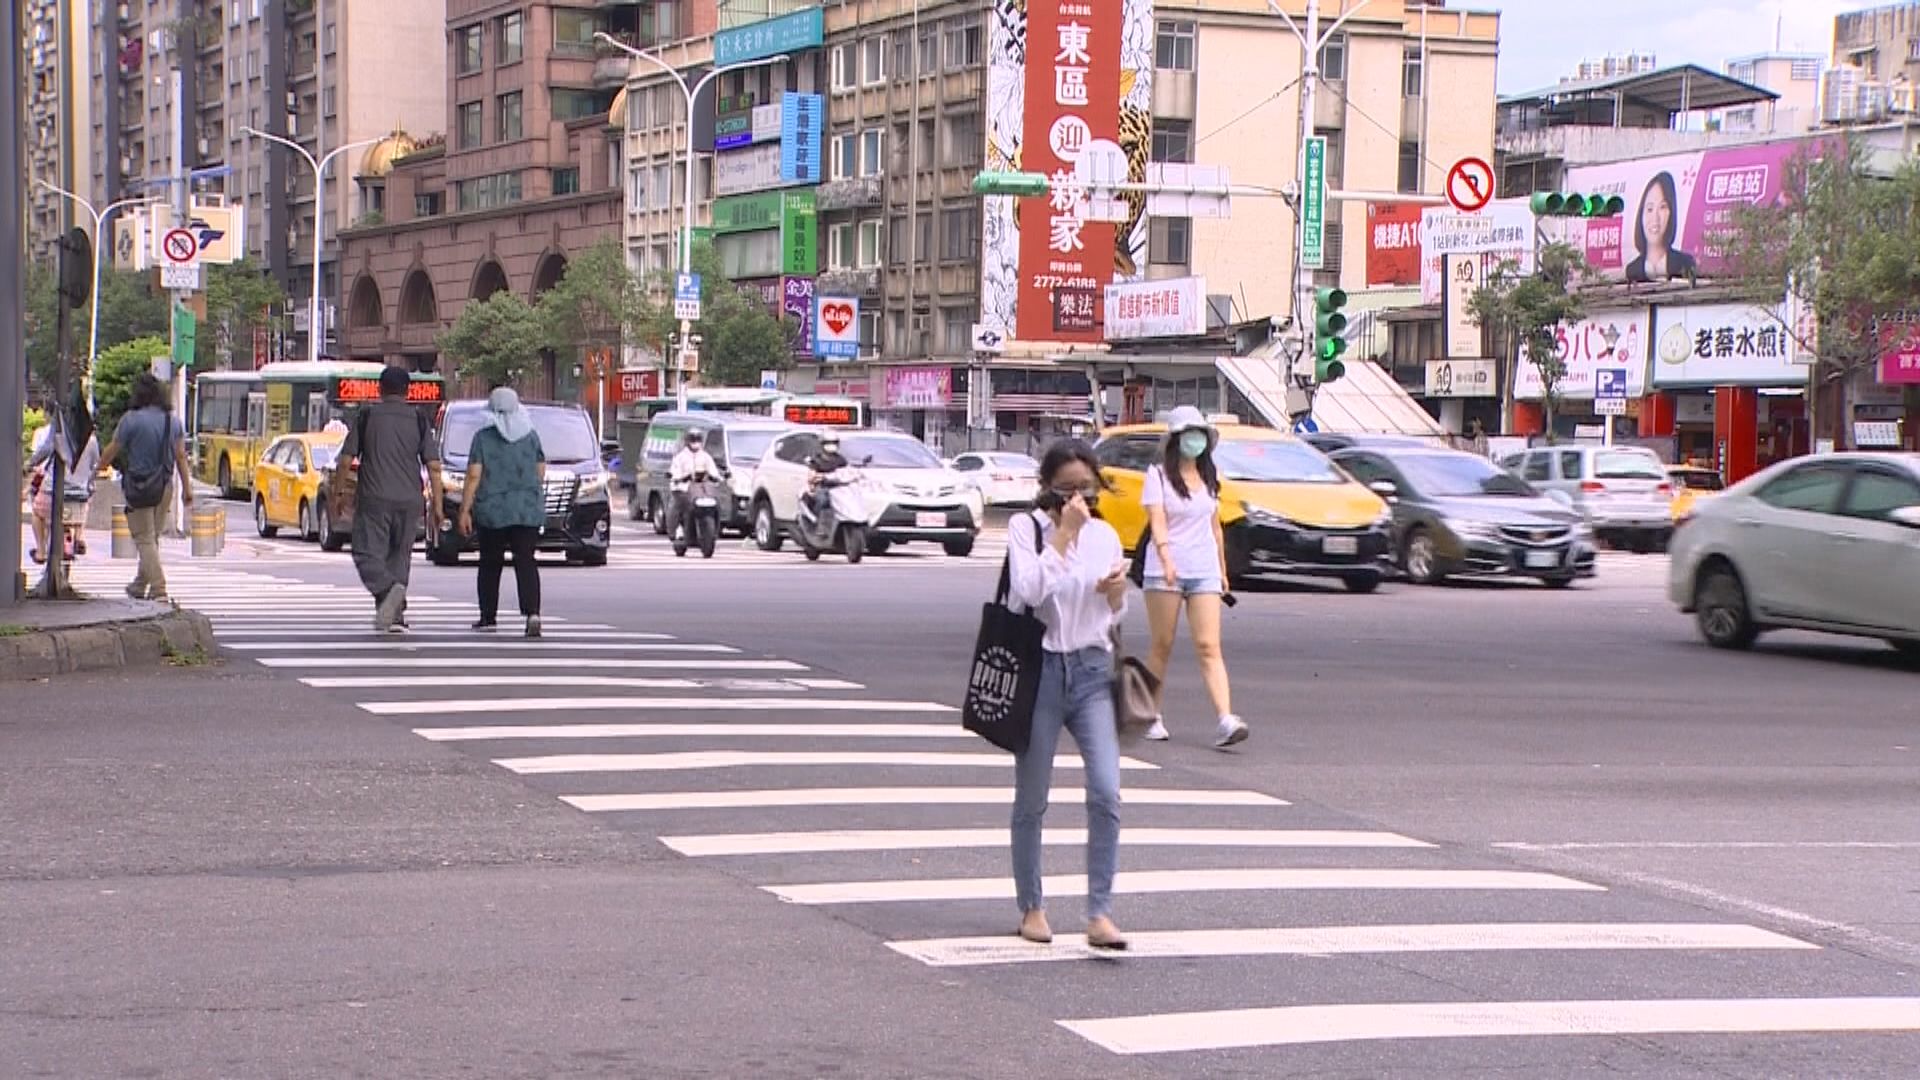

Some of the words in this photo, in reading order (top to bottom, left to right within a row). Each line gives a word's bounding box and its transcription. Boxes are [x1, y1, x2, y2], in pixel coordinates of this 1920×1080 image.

[1712, 171, 1762, 197] 聯絡站
[1060, 293, 1093, 317] 樂法
[622, 373, 649, 390] GNC
[1599, 372, 1614, 392] P
